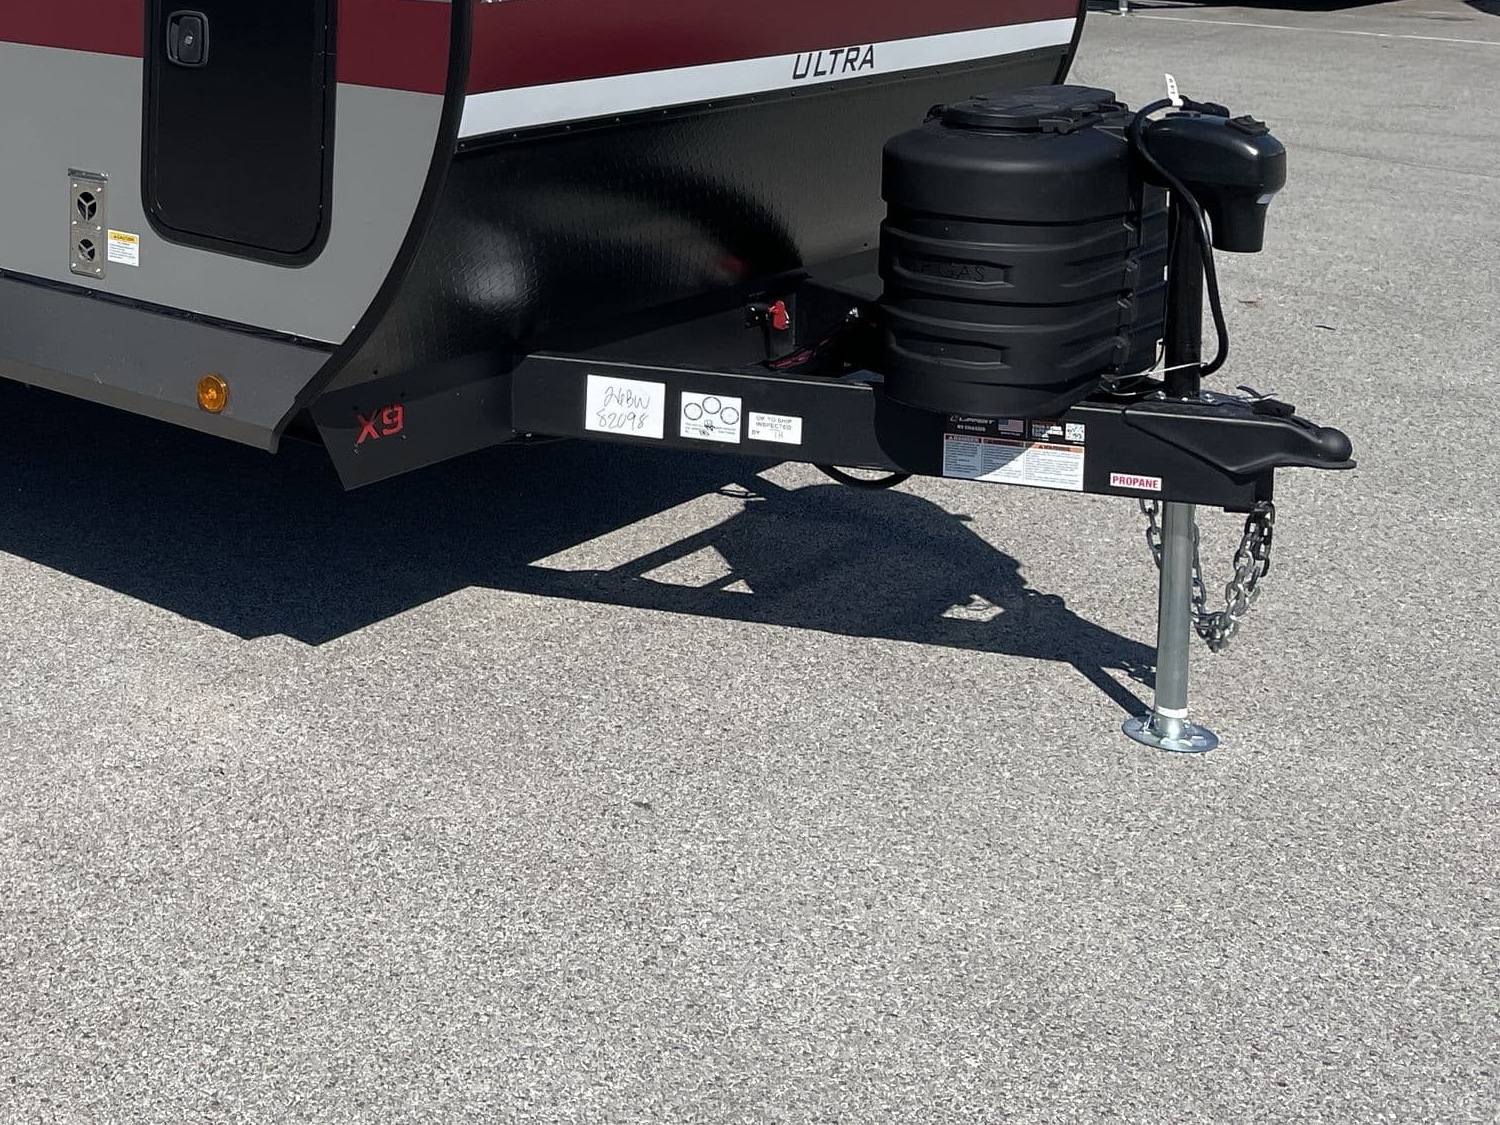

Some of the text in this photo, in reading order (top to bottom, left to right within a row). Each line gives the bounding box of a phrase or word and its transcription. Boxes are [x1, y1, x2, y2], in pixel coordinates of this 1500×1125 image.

[792, 44, 874, 80] ULTRA
[356, 405, 404, 444] X9
[1112, 475, 1160, 489] PROPANE
